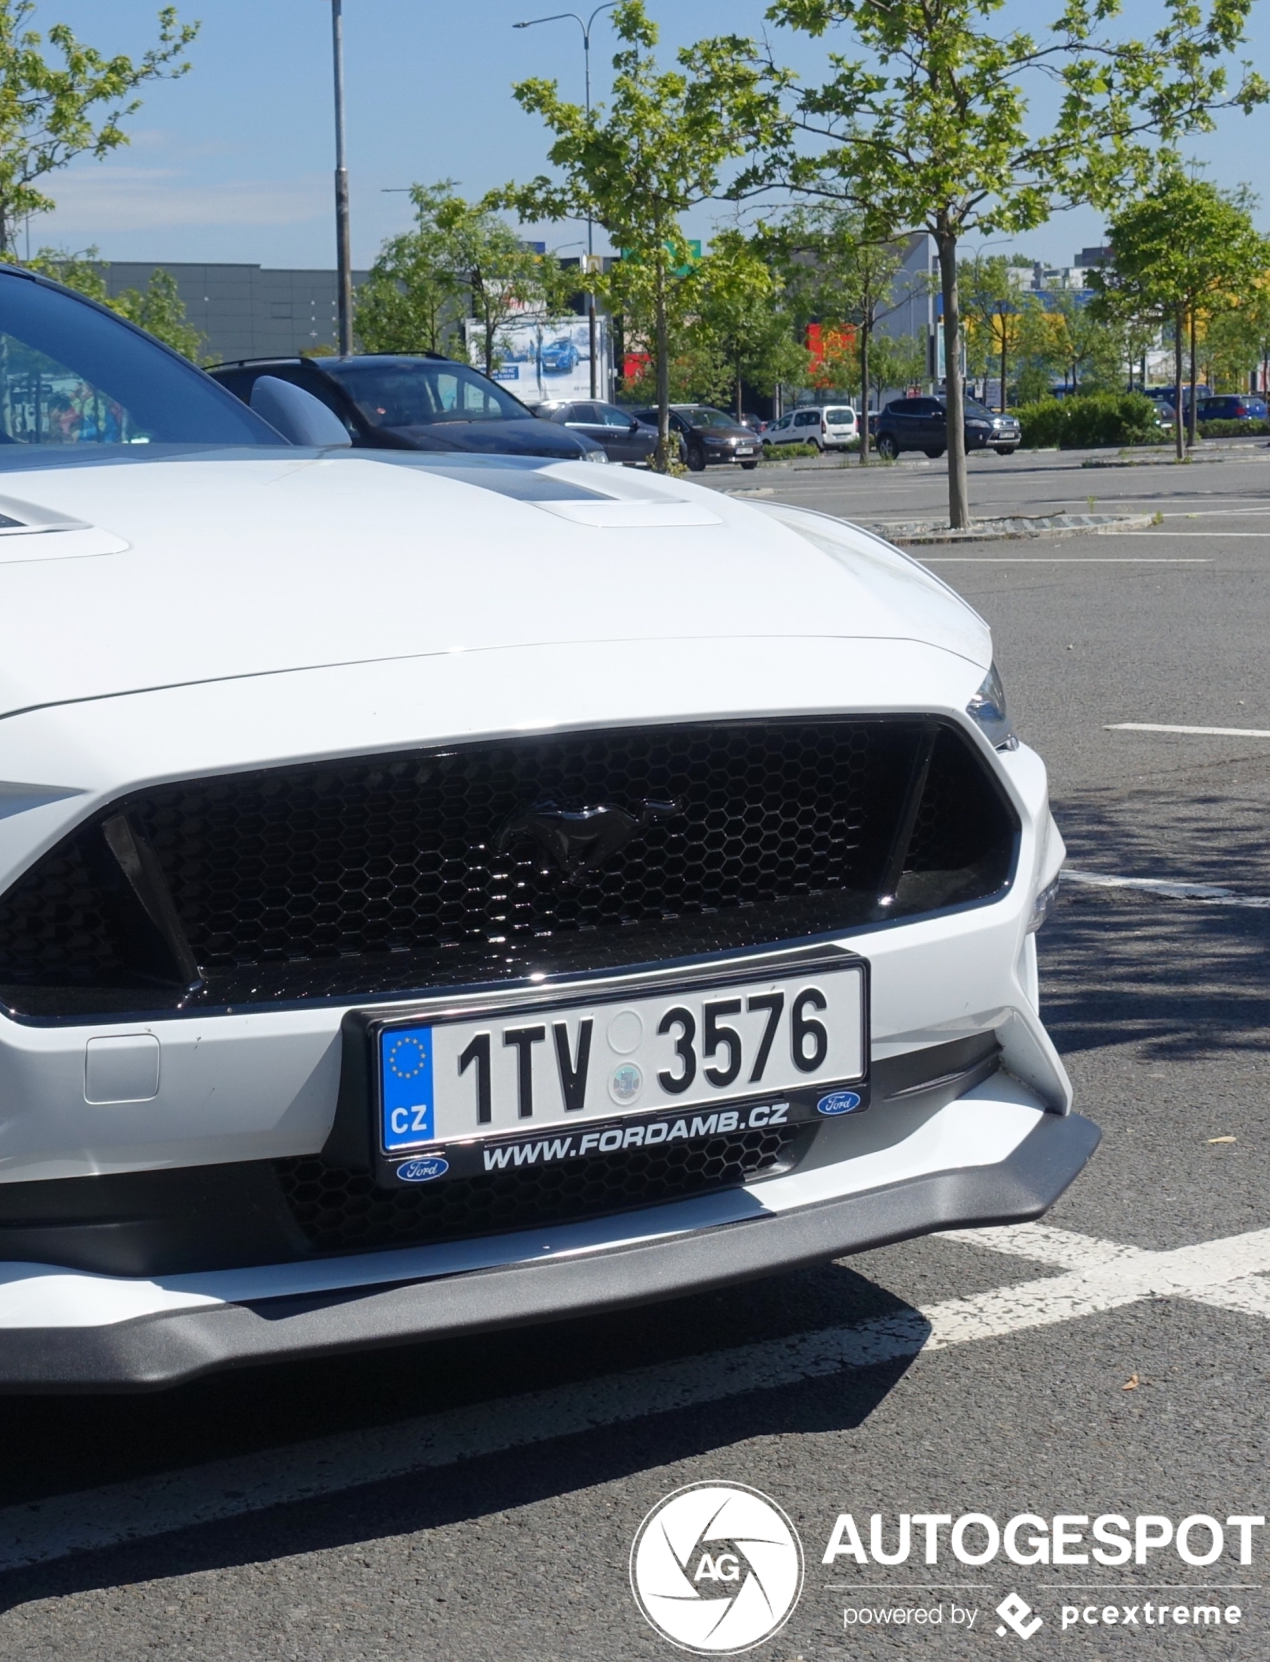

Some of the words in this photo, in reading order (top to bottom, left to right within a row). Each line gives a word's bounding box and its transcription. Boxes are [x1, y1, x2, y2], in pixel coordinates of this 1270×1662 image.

[457, 1017, 594, 1126] 1TV
[656, 986, 829, 1095] 3576
[390, 1103, 429, 1135] CZ
[822, 1093, 856, 1113] Ford
[482, 1102, 789, 1172] WWW.FORDAMB.CZ
[402, 1159, 441, 1180] Ford
